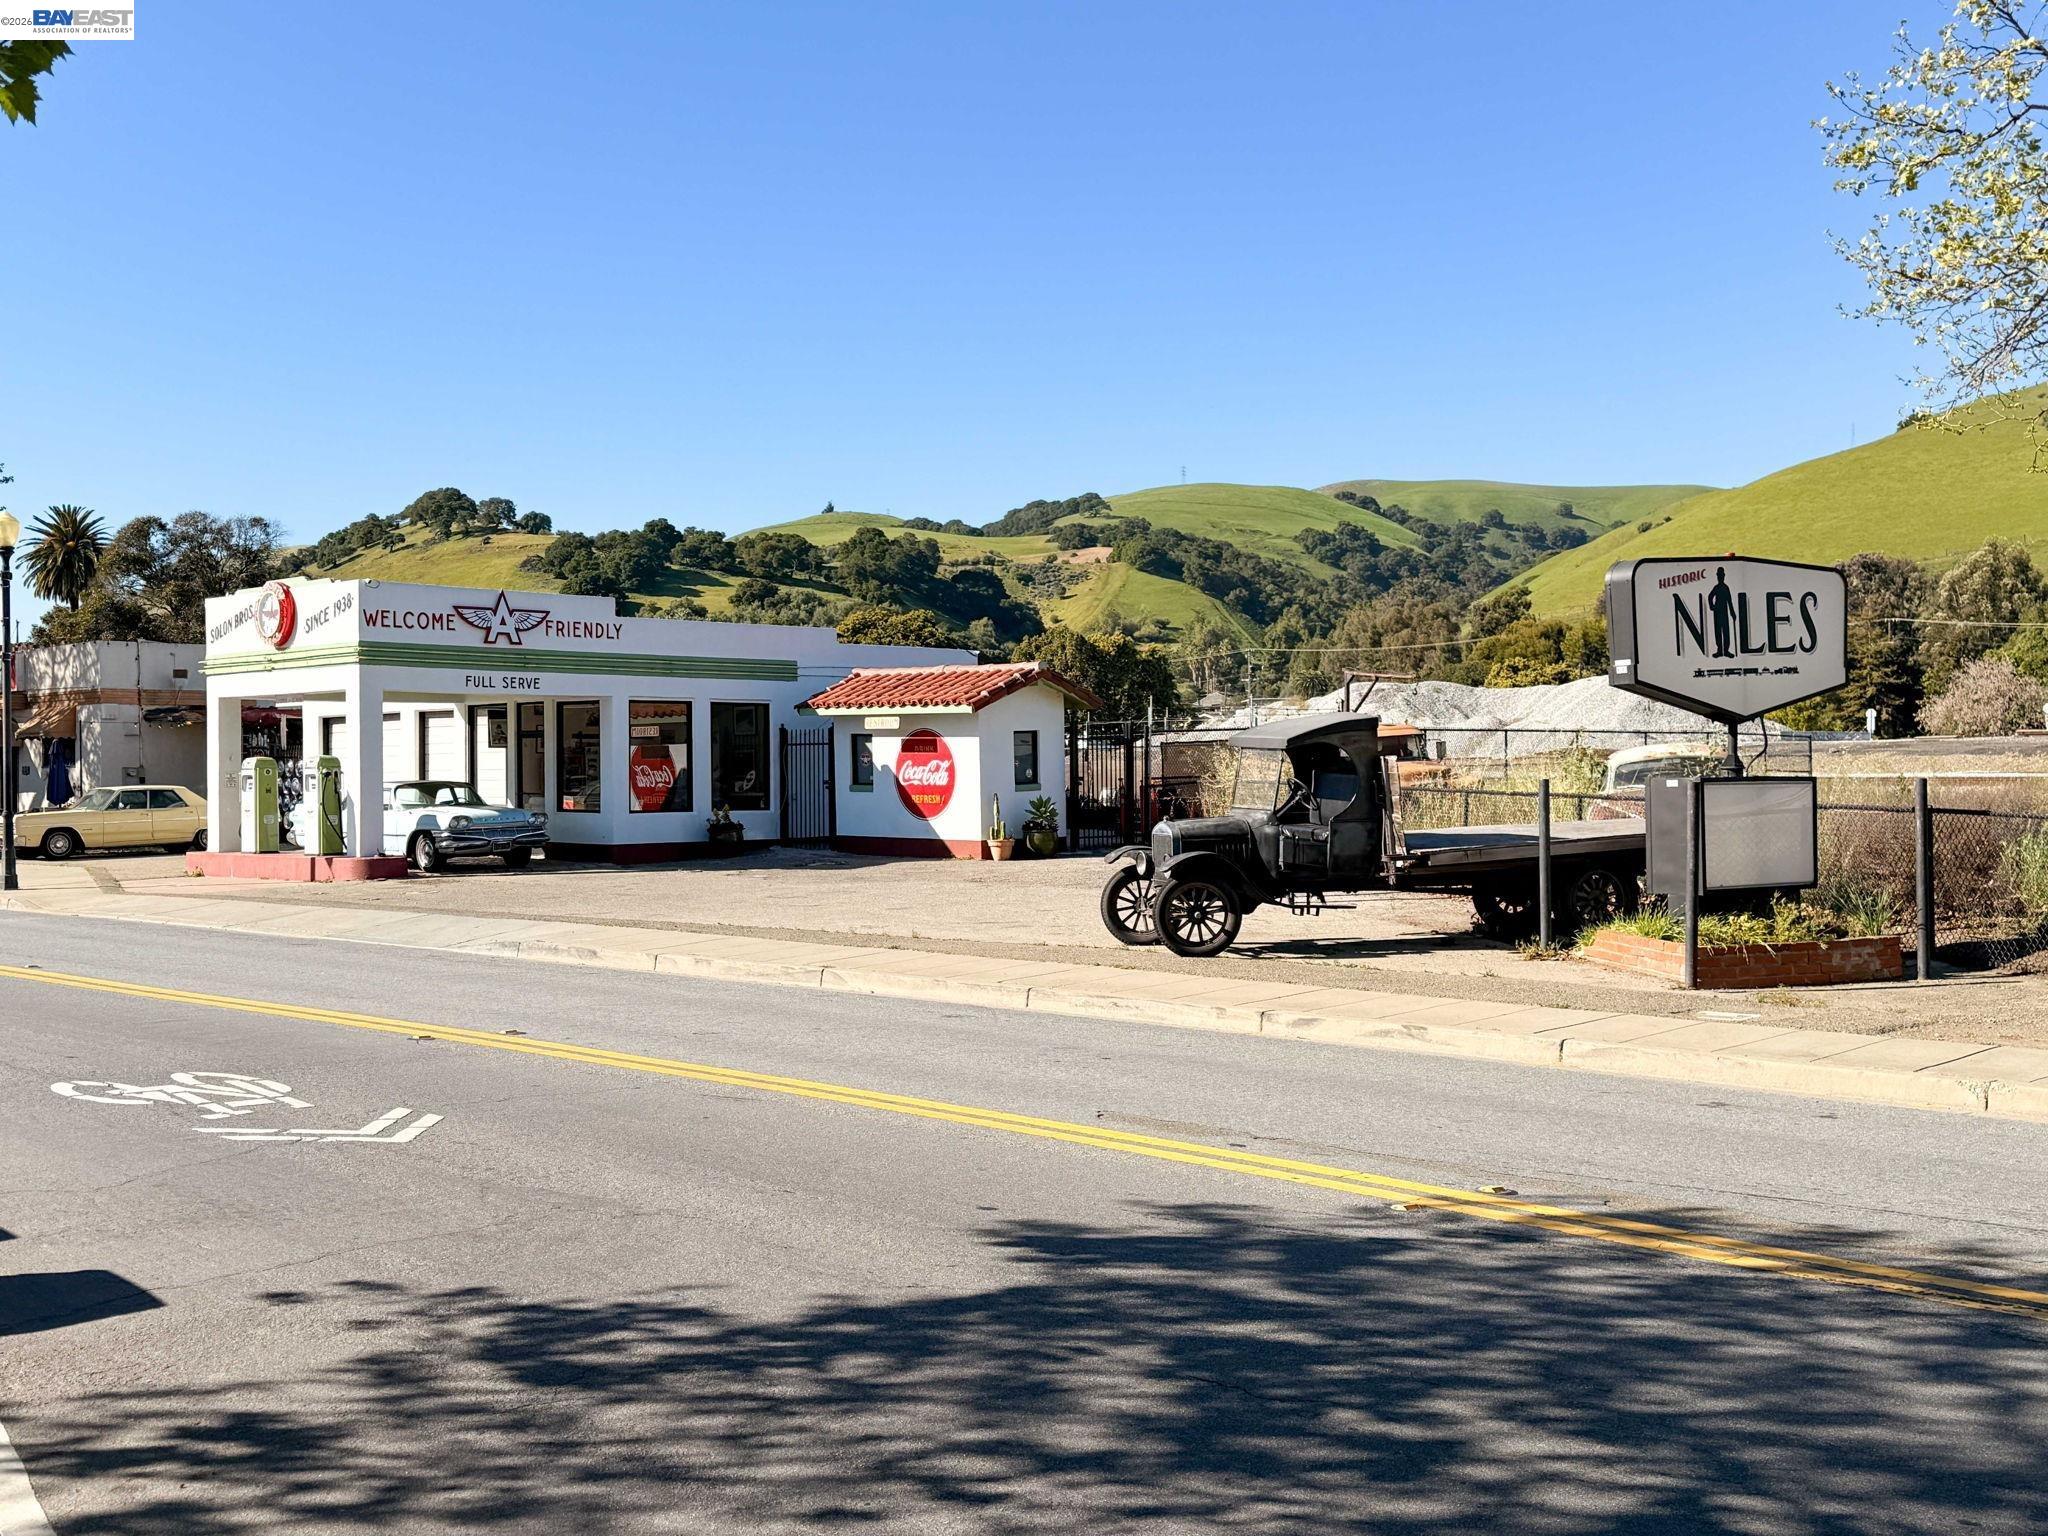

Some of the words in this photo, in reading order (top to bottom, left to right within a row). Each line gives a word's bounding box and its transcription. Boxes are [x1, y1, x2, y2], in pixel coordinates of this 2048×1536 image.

[1659, 569, 1706, 589] HISTORIC
[305, 606, 329, 634] SINCE
[363, 608, 456, 631] WELCOME
[545, 620, 623, 640] FRIENDLY
[210, 617, 232, 644] SOLON
[465, 675, 496, 688] FULL
[502, 677, 540, 689] SERVE
